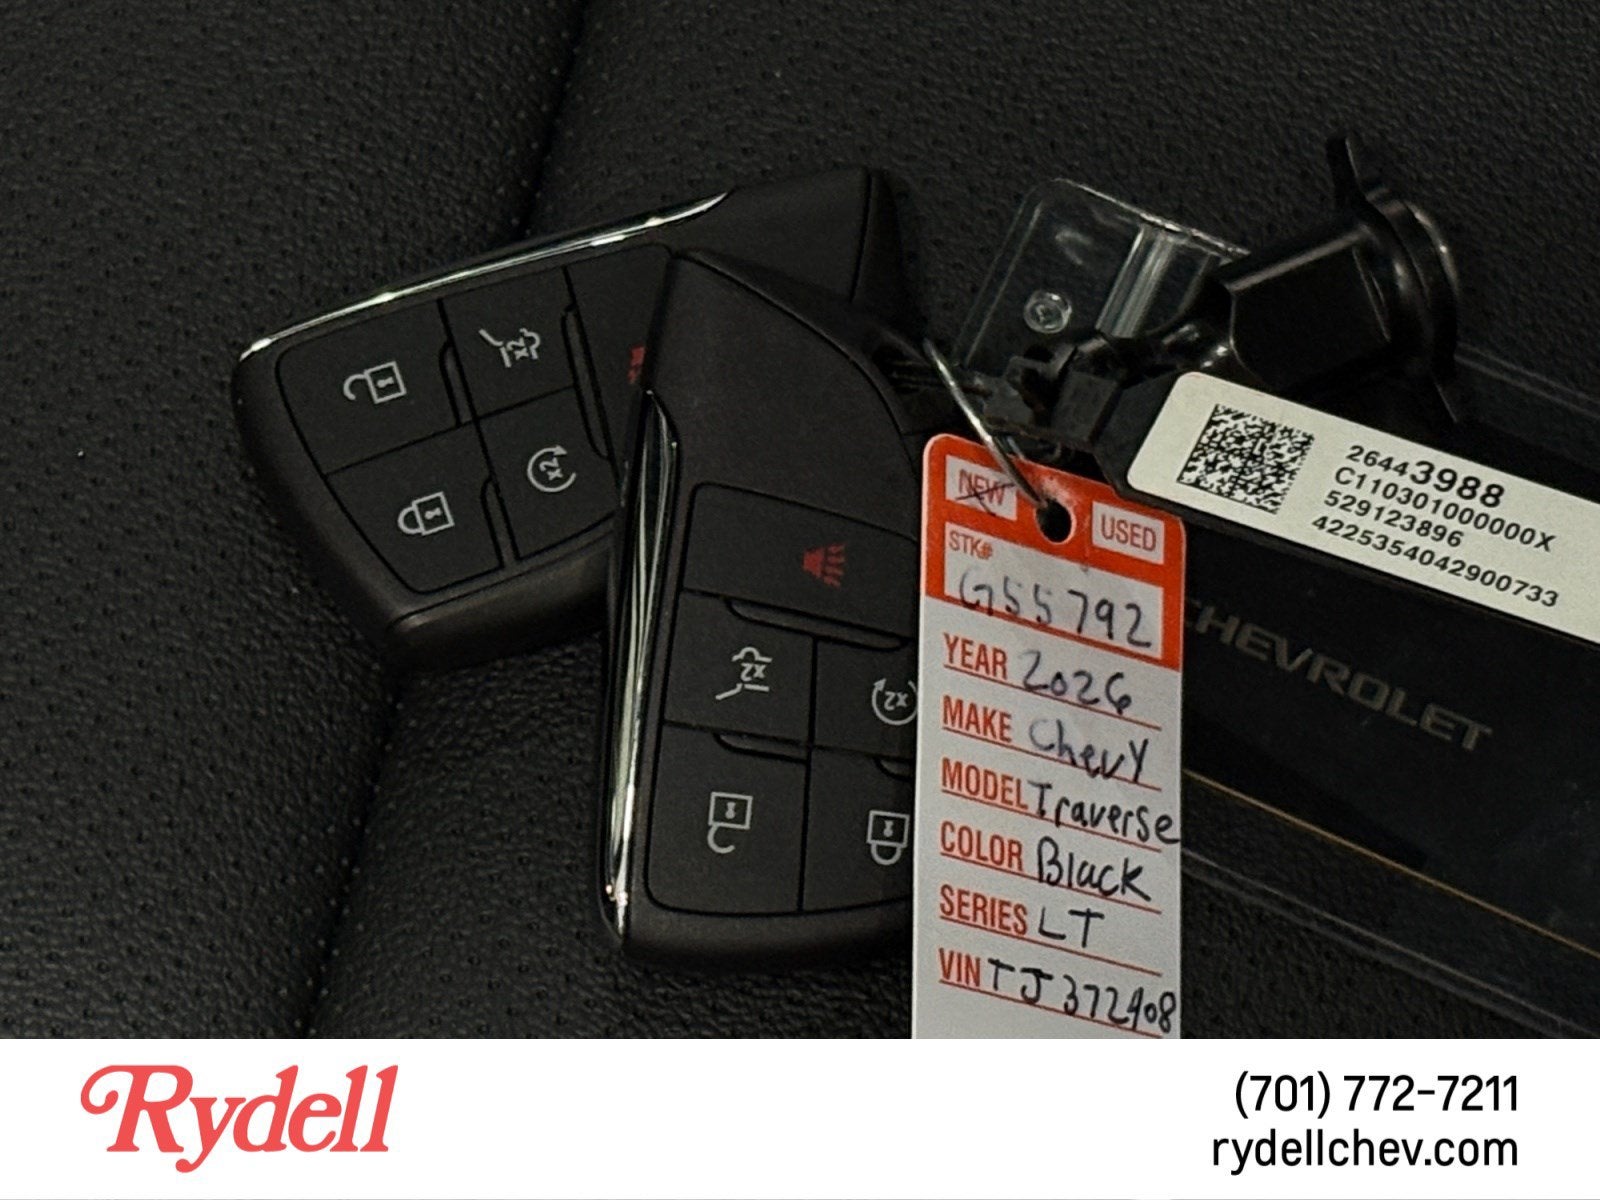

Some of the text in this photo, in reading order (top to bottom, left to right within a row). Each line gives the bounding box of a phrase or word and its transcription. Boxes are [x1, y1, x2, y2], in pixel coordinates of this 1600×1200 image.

[1335, 466, 1556, 552] C110301000000X
[1346, 445, 1505, 508] 26443988
[949, 531, 993, 560] STK#
[1101, 513, 1156, 552] USED
[1324, 490, 1464, 547] 529123896
[1312, 515, 1559, 607] 4225354042900733
[959, 569, 1151, 649] G55792
[943, 632, 1132, 715] YEAR 2026
[1187, 599, 1492, 751] HEVROLET
[942, 695, 1012, 743] MAKE
[941, 757, 1181, 845] MODEL Traverse
[940, 820, 1151, 902] COLOR Black
[939, 884, 1105, 949] SERIES LT
[938, 947, 981, 988] VIN
